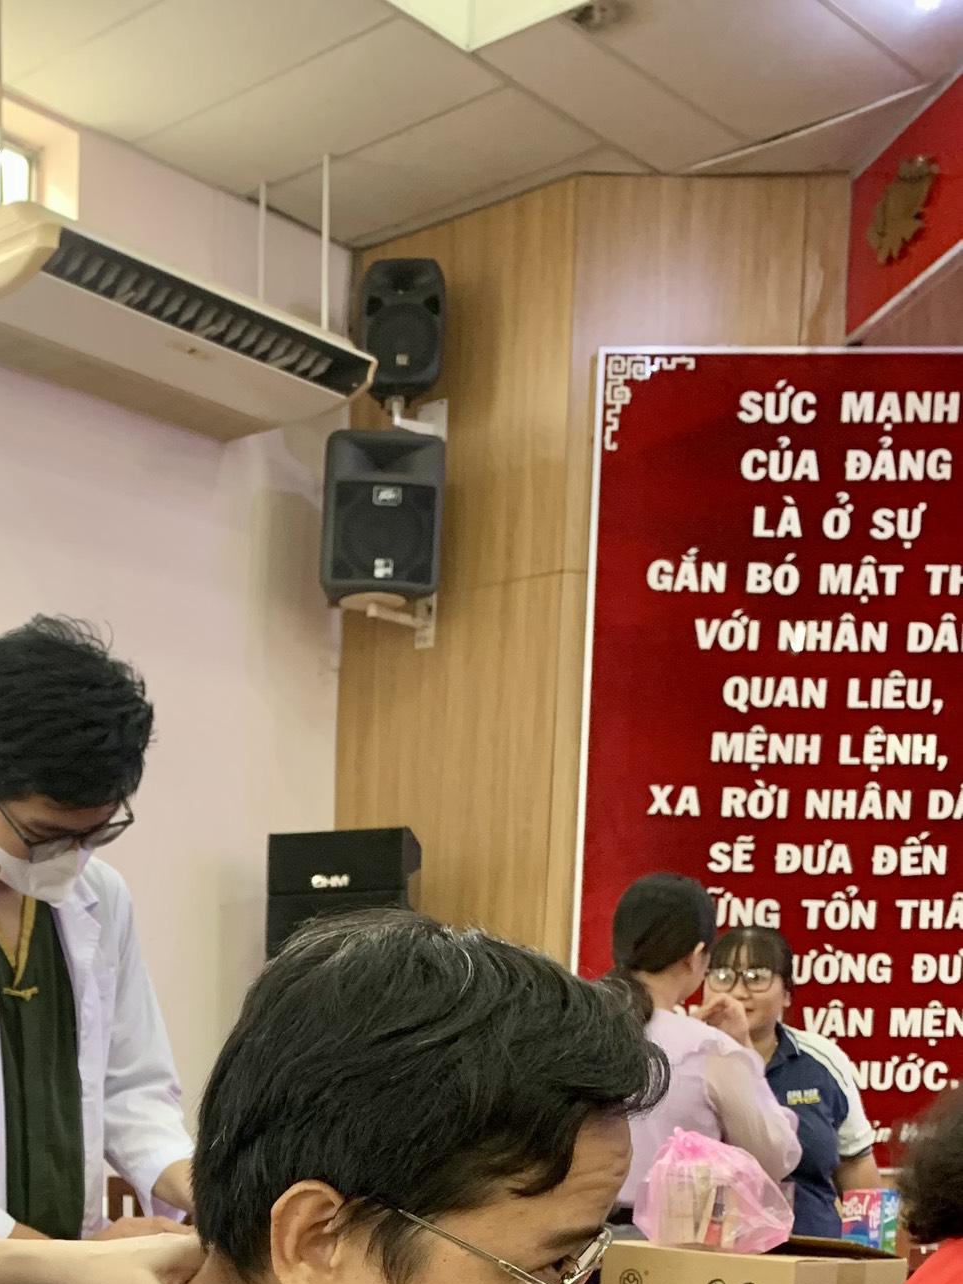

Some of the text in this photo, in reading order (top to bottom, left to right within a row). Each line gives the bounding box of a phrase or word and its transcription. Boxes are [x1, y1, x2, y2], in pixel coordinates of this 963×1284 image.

[738, 380, 960, 431] SỨC MẠNH
[741, 436, 952, 481] CỦA ĐẢNG
[753, 492, 926, 549] LÀ Ở SỰ
[647, 548, 726, 592] GẮN
[746, 553, 799, 595] BÓ
[819, 555, 904, 603] MẬT
[695, 609, 963, 653] VỚI NHÂN DÂ
[723, 670, 943, 714] QUAN LIÊU,
[711, 725, 947, 772] MỆNH LỆNH,
[647, 785, 700, 816] XA
[721, 780, 788, 819] RỜI
[805, 782, 911, 819] NHÂN
[707, 832, 947, 876] SẼ ĐƯA ĐẾN
[801, 886, 876, 930] TỔN
[792, 943, 892, 985] ƯỜNG
